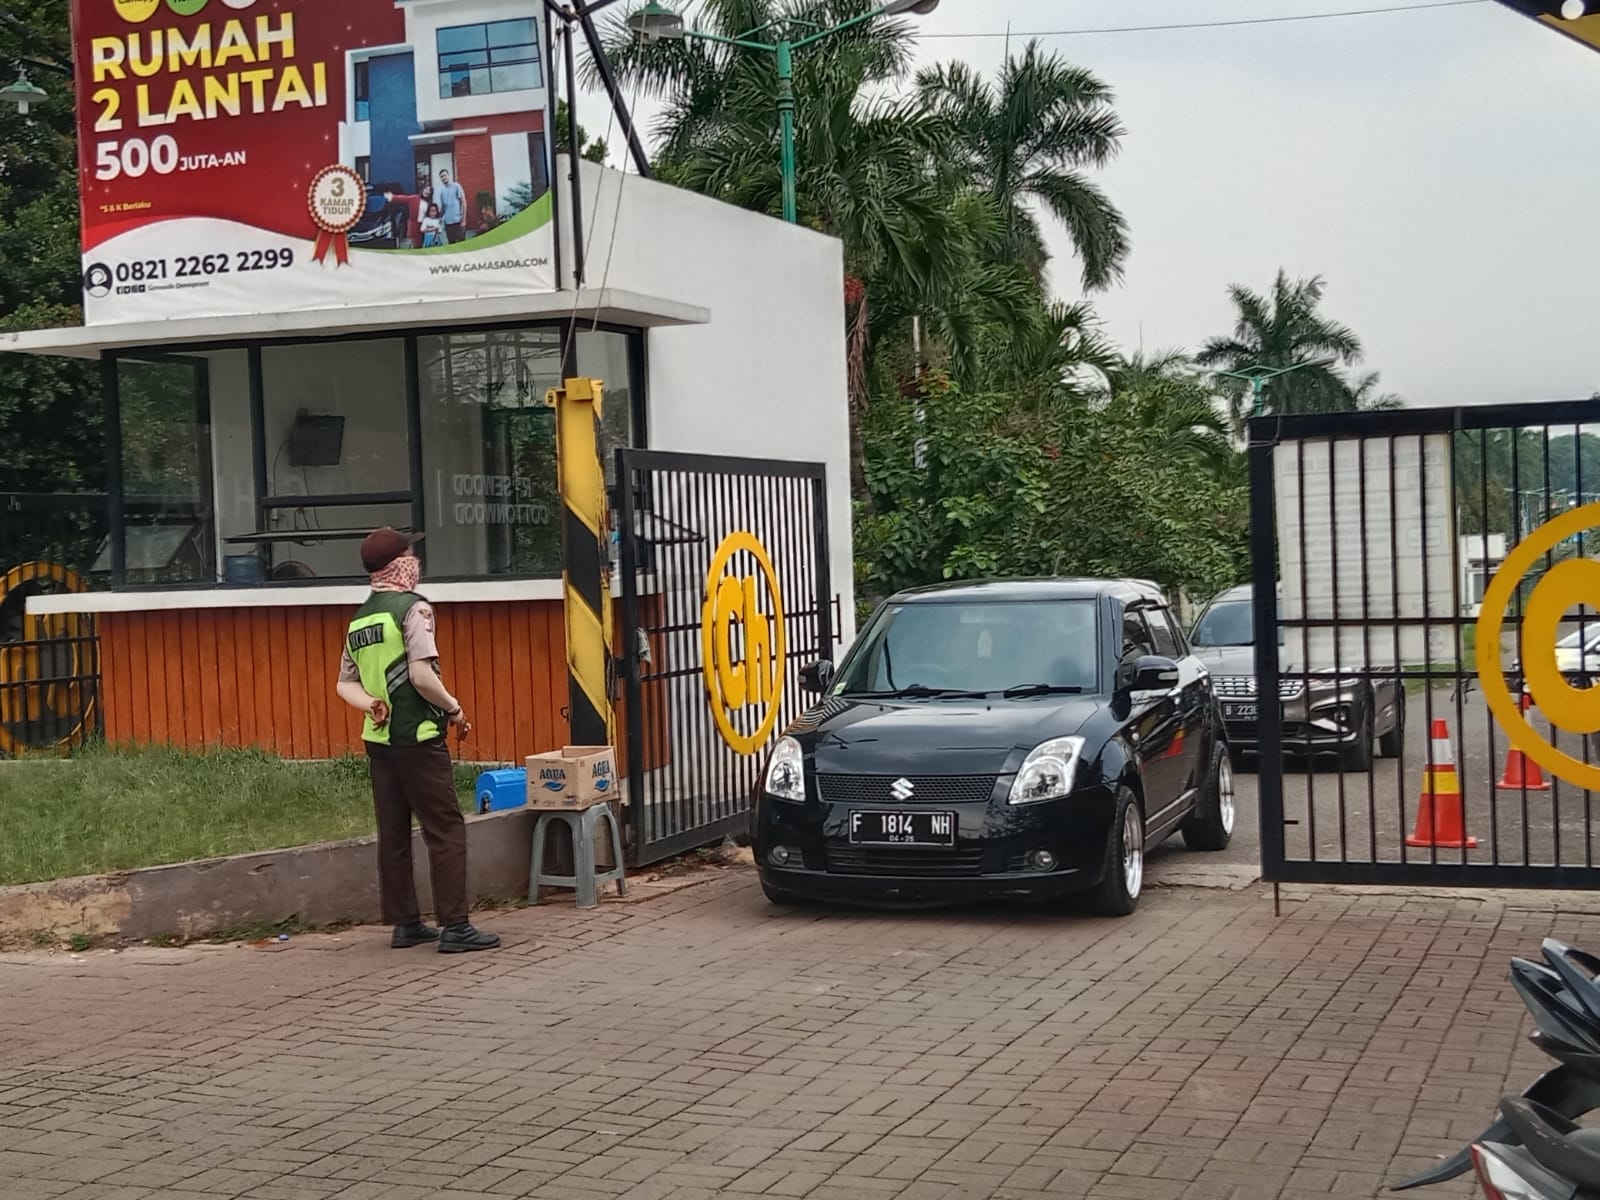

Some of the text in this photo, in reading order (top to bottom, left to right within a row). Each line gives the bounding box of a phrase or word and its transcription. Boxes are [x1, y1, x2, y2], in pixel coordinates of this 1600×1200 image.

[91, 12, 295, 83] RUMAH
[92, 62, 328, 133] 2 LANTAI
[95, 134, 246, 181] 500 JUTA-AN
[331, 177, 345, 197] 3
[320, 198, 354, 207] KAMAR
[322, 206, 351, 215] TIDUR
[116, 248, 294, 282] 0821 2262 2299
[429, 257, 548, 275] WWW.GAMASADA.COM
[539, 769, 566, 780] AQUA
[853, 814, 950, 835] F 1814 NH
